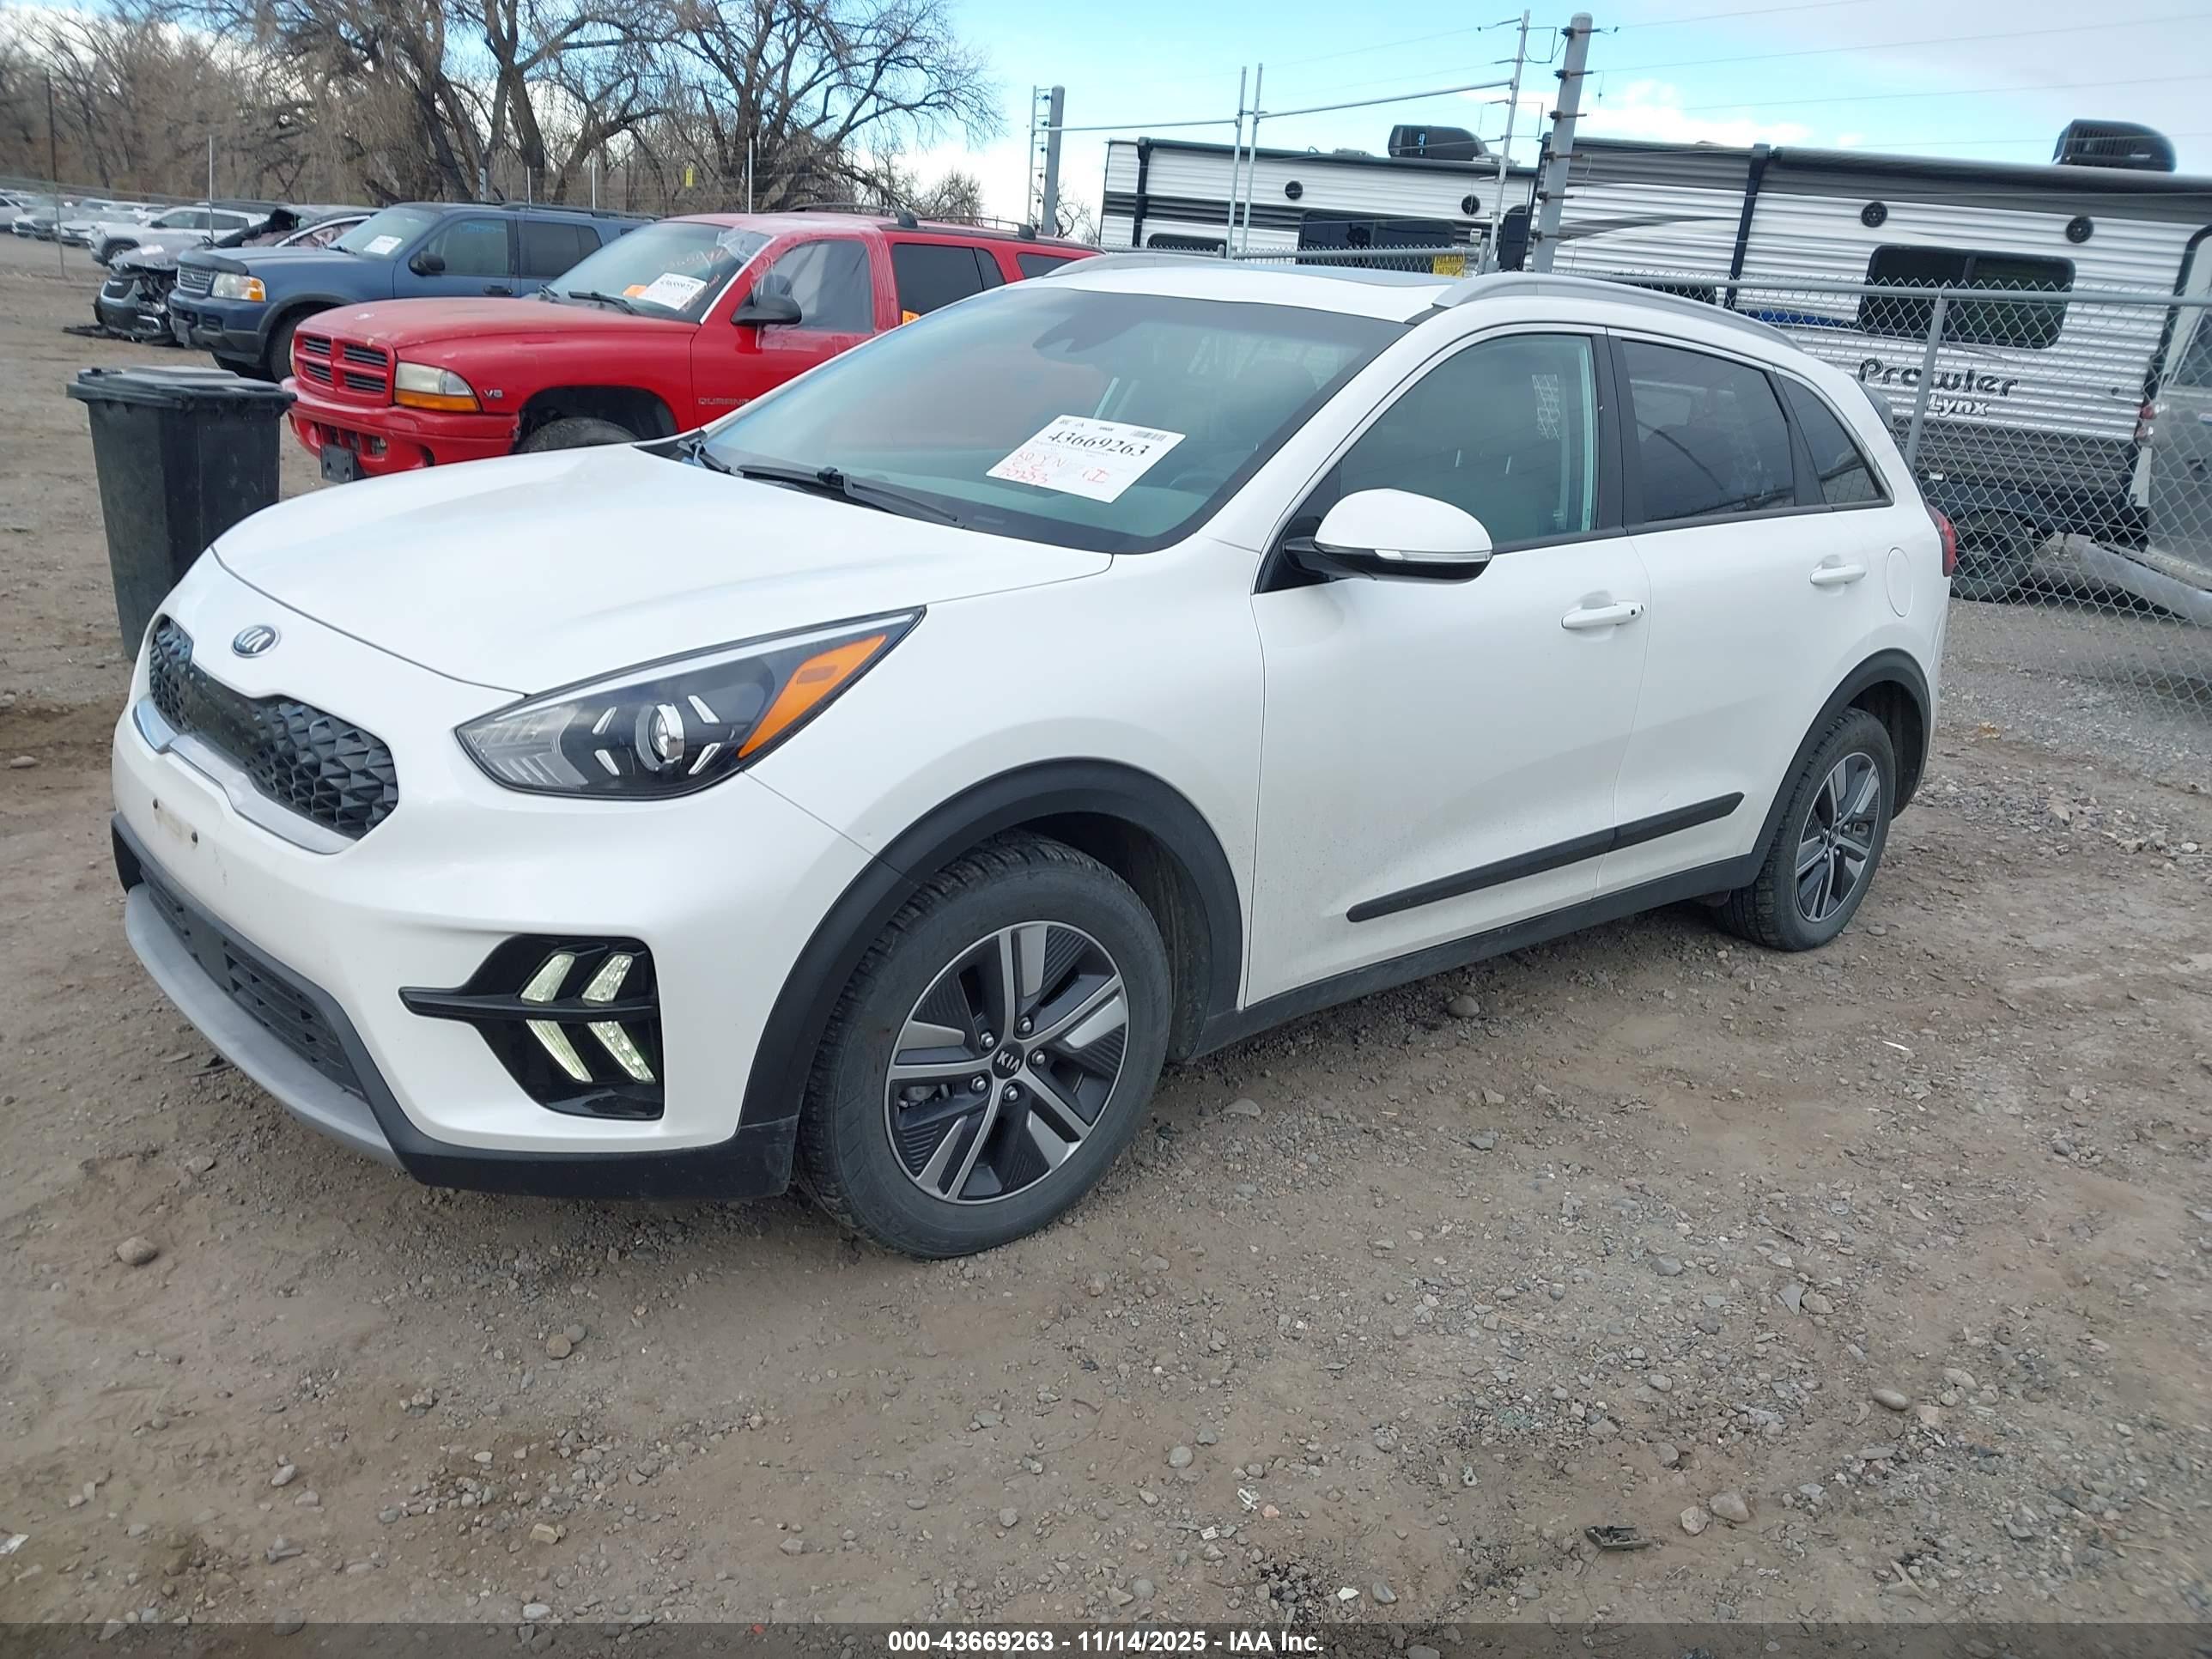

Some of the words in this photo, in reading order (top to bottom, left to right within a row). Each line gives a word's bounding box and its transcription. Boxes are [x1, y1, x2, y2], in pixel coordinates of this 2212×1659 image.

[1857, 357, 2019, 397] Prowler
[1926, 393, 1989, 417] Lynx
[1048, 430, 1151, 457] 43669263
[996, 1050, 1021, 1073] KIA
